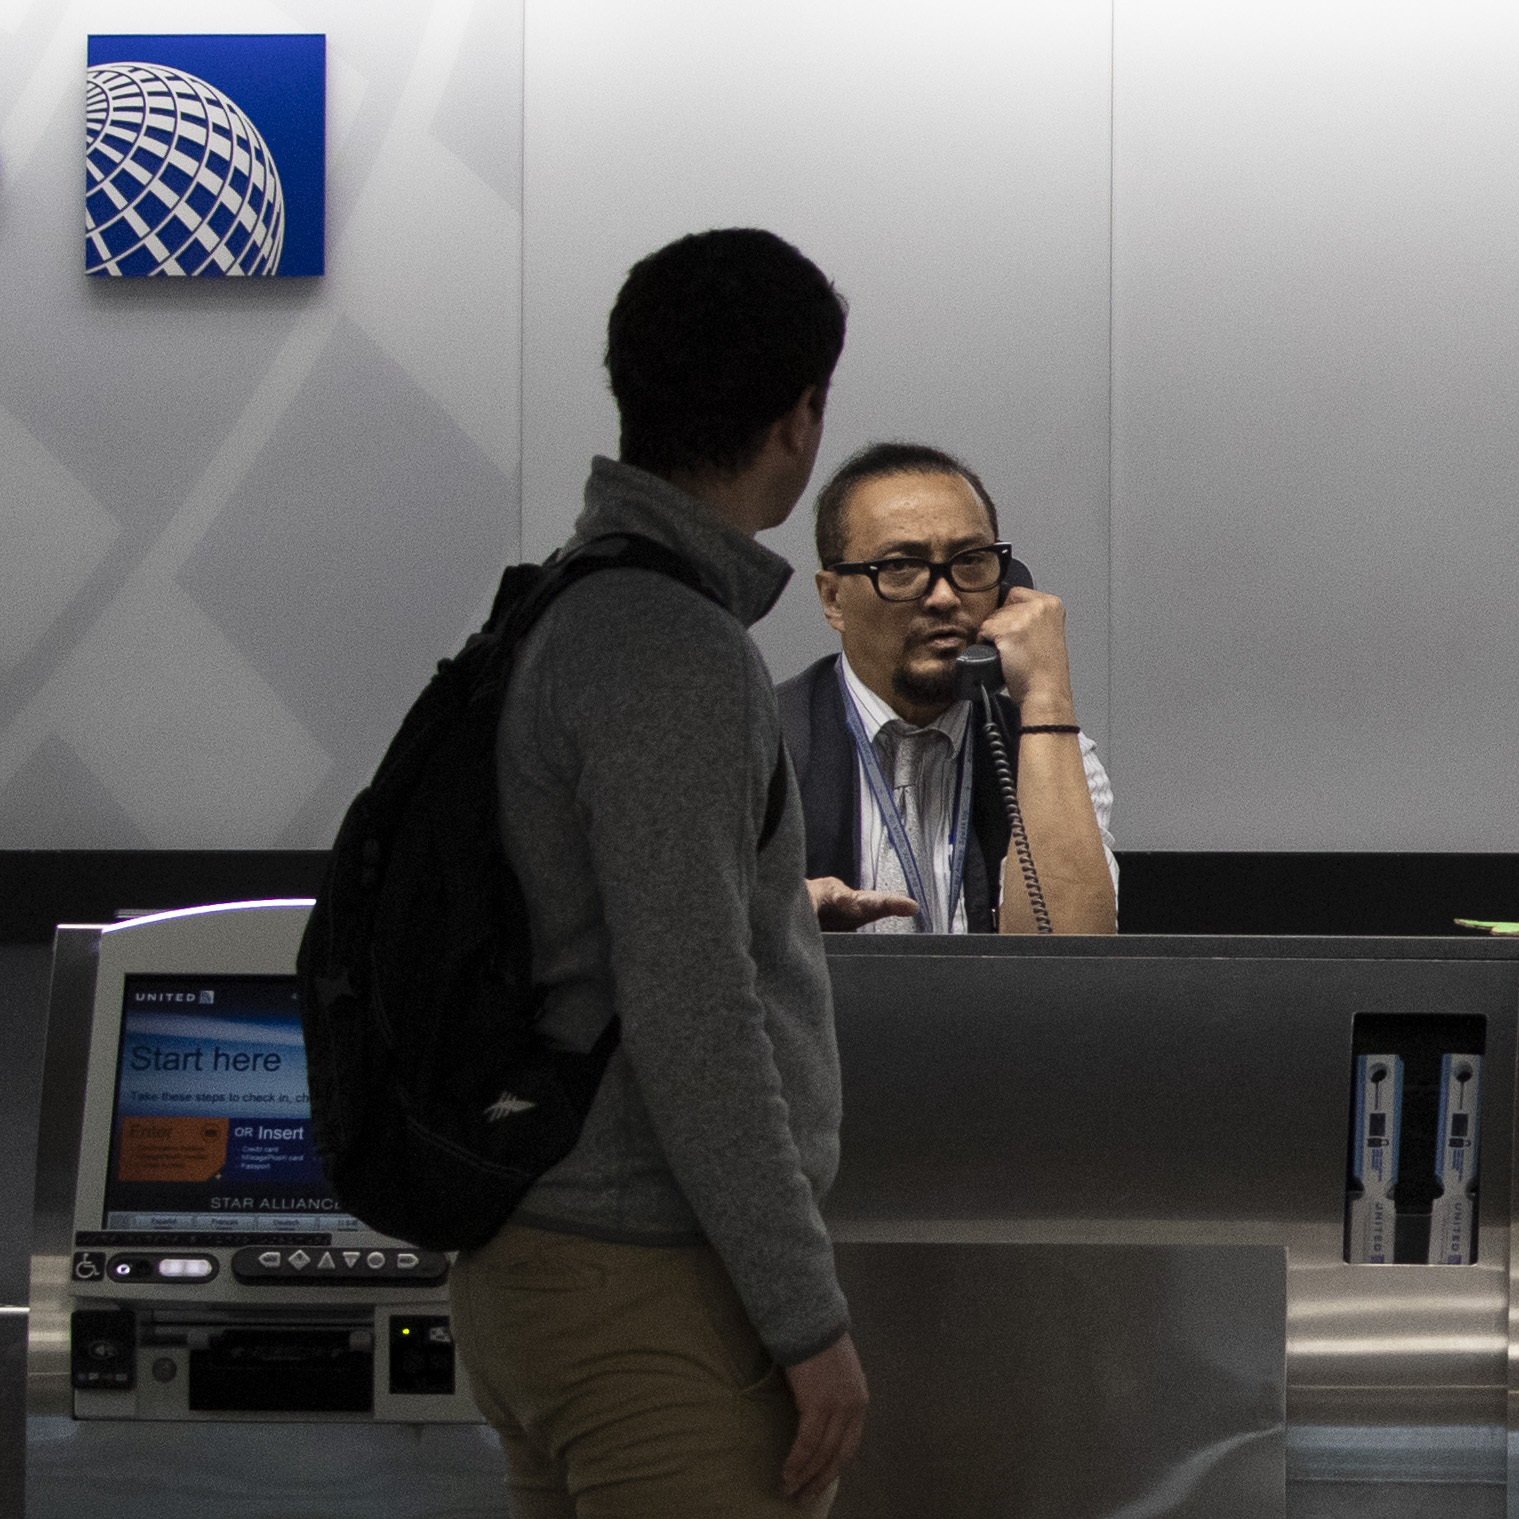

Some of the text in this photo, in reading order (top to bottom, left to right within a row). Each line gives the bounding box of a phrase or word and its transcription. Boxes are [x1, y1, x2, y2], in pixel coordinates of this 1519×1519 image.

[135, 992, 196, 1003] UNITED
[130, 1045, 282, 1072] Start here
[131, 1091, 157, 1102] Take
[162, 1091, 192, 1102] these
[195, 1092, 226, 1104] steps
[229, 1092, 240, 1102] to
[242, 1091, 274, 1102] check
[234, 1126, 304, 1140] OR Insert
[210, 1197, 254, 1209] STAR
